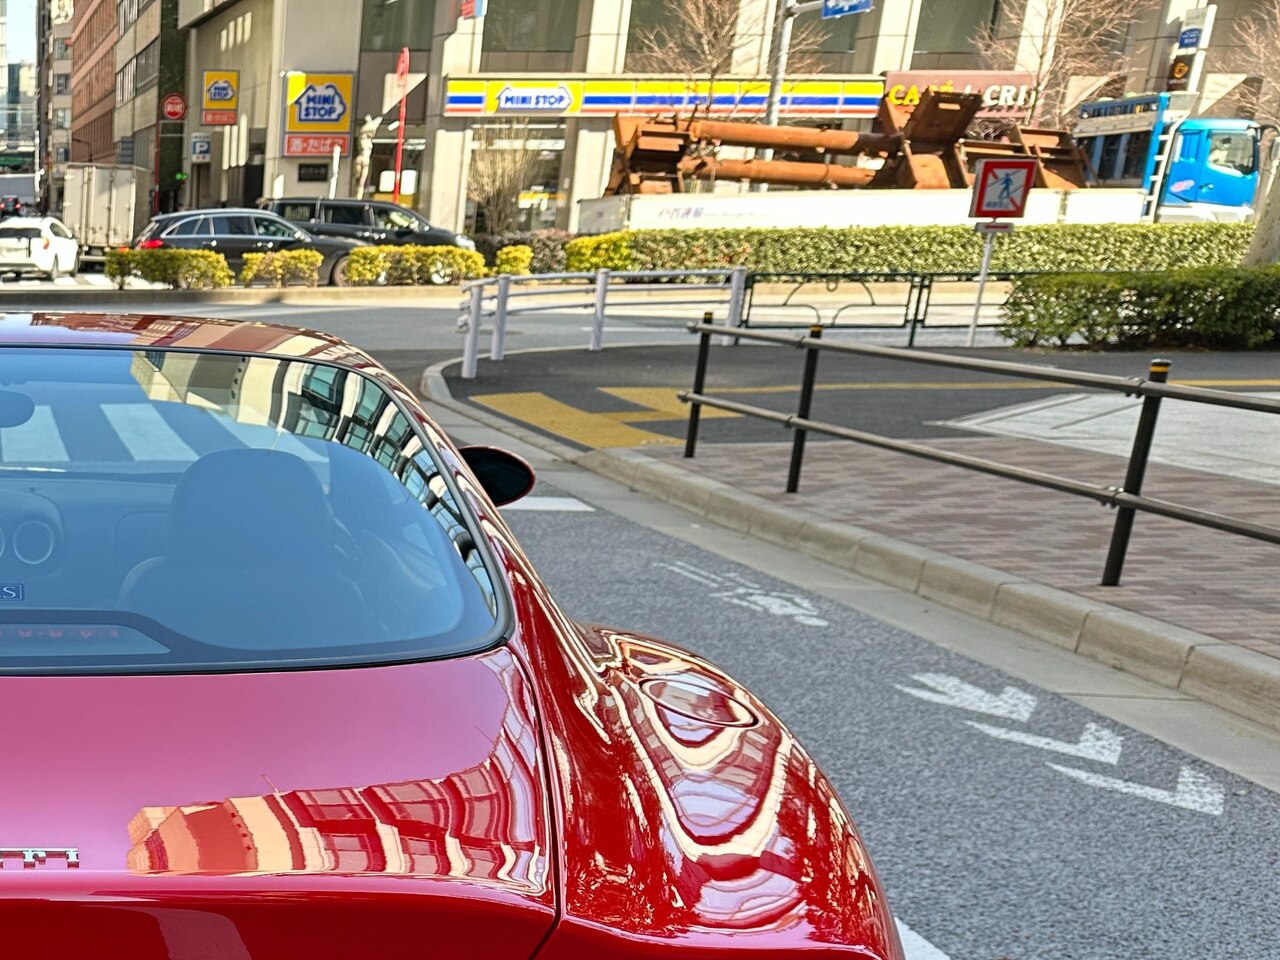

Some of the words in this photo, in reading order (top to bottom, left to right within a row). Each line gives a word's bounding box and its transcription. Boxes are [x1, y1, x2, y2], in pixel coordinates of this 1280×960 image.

[306, 93, 336, 105] MINI
[504, 95, 531, 105] MINI
[535, 95, 565, 105] STOP
[304, 105, 337, 117] STOP
[195, 142, 209, 154] P
